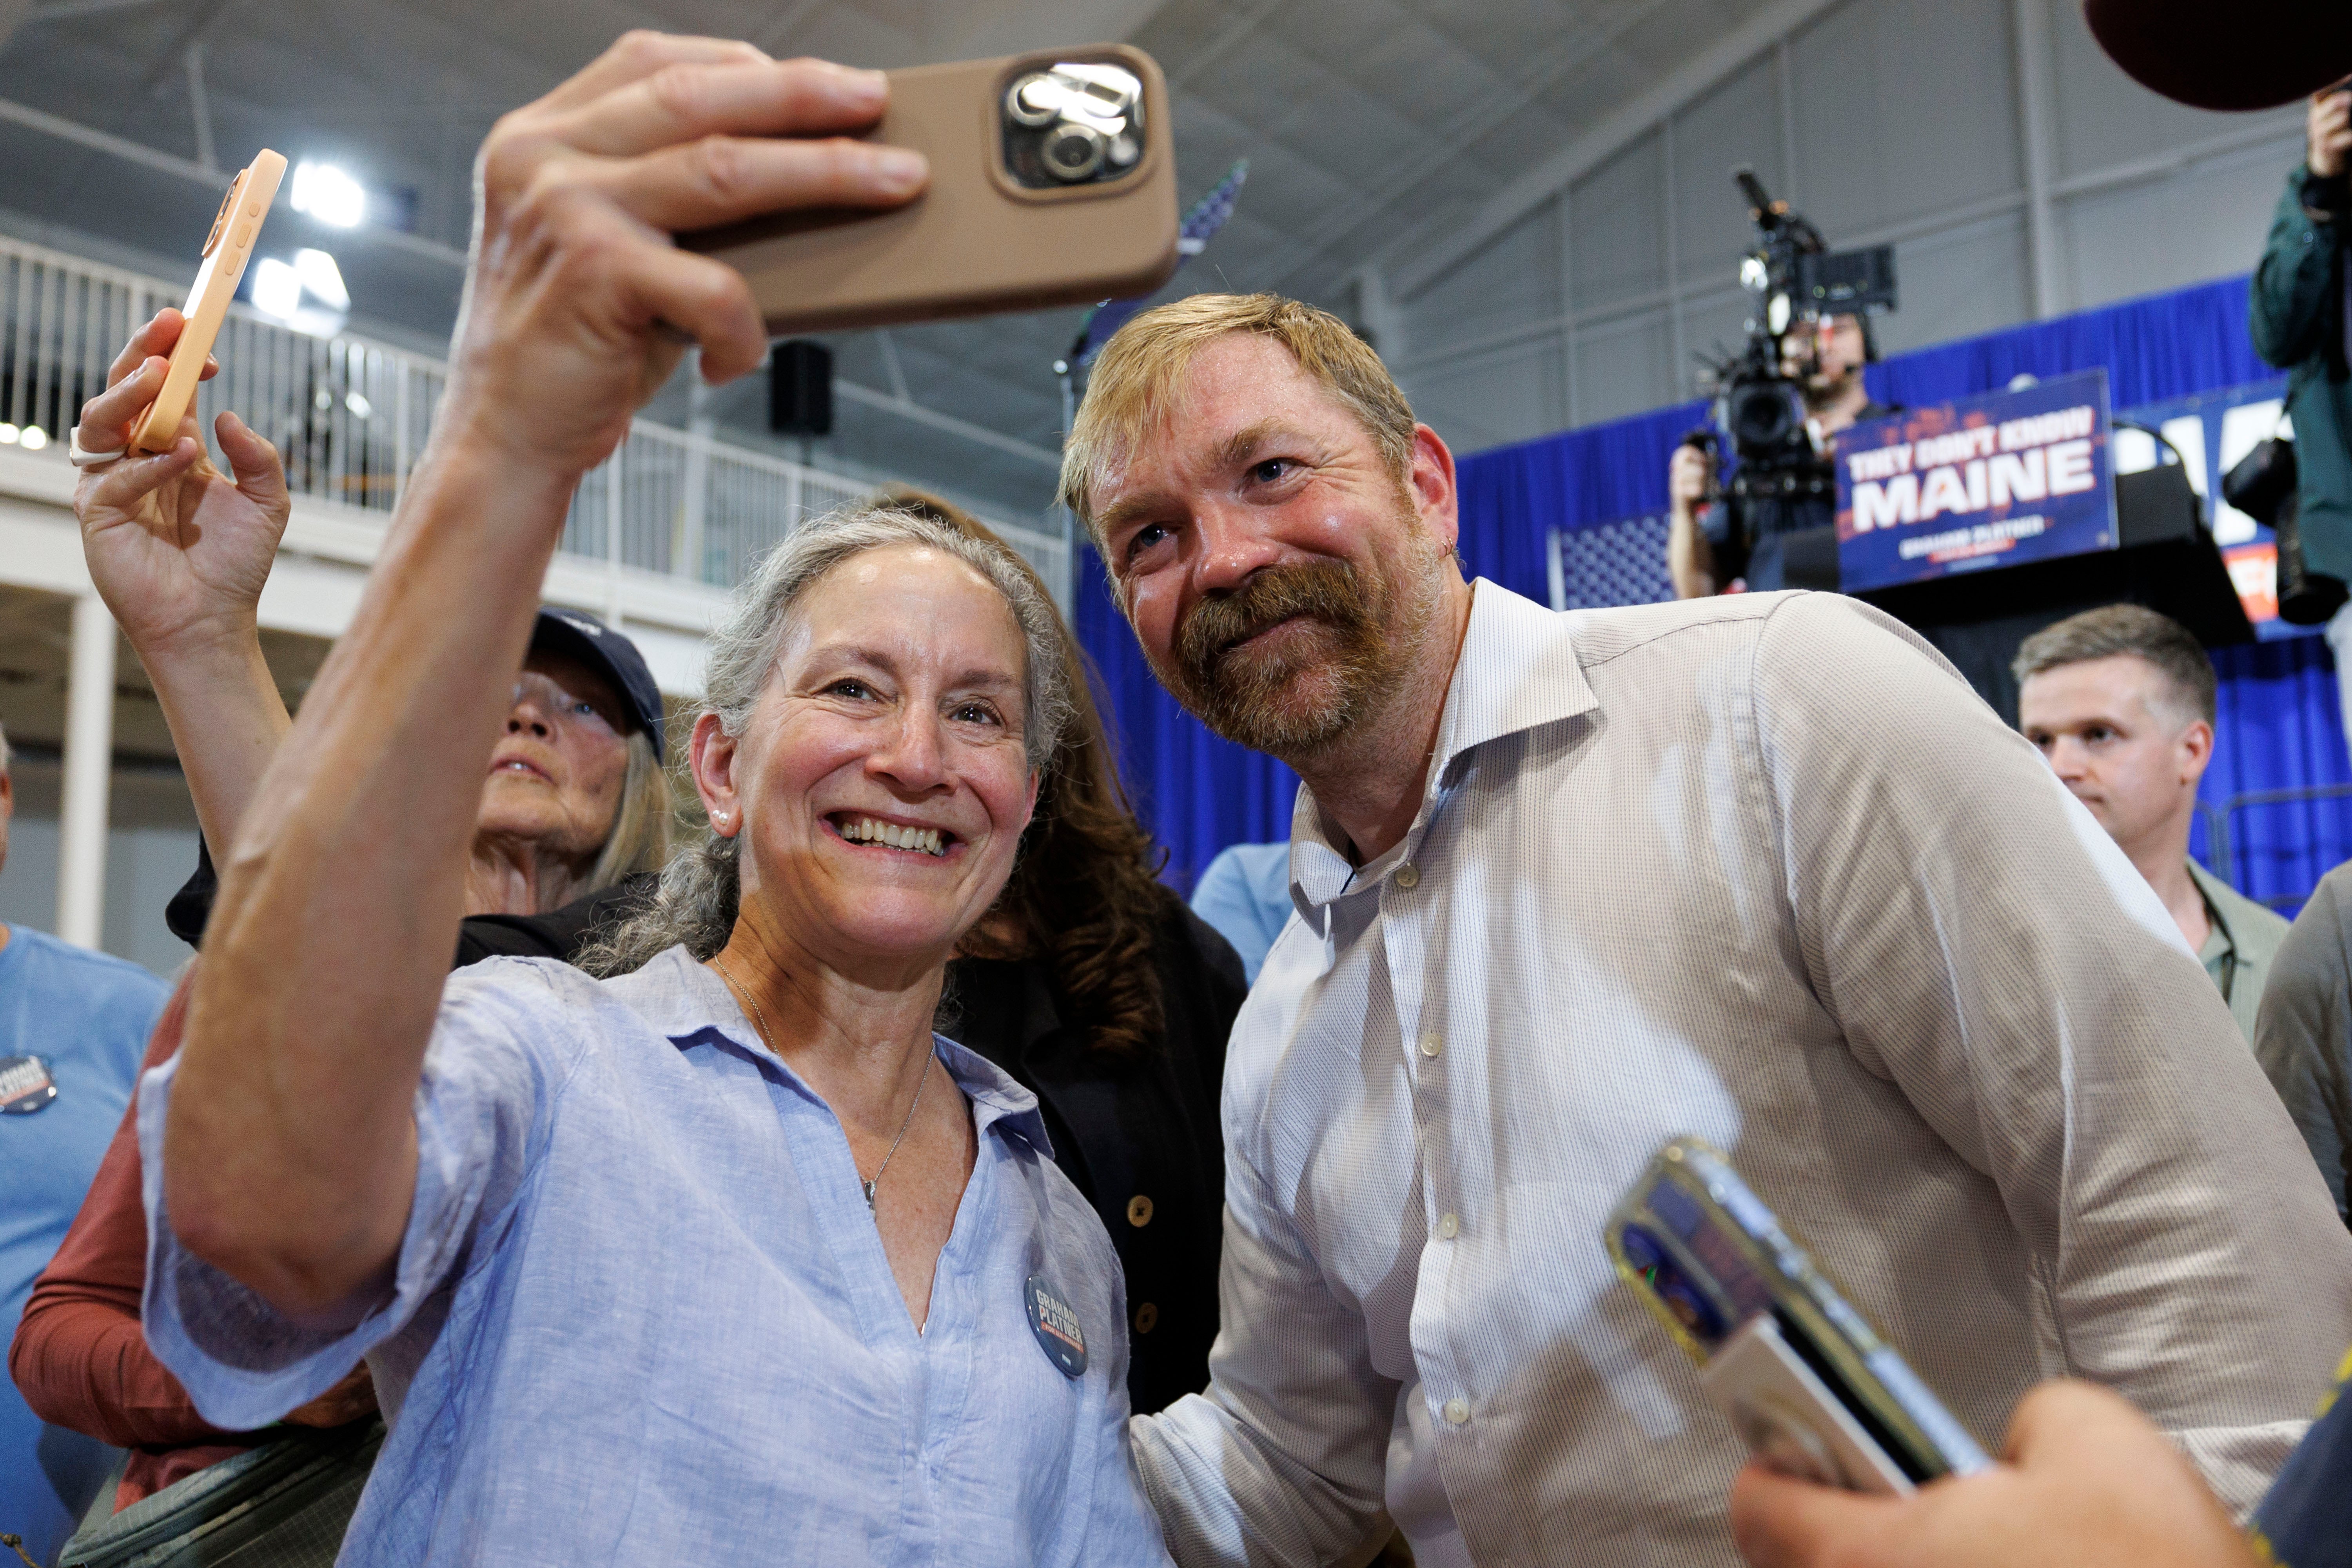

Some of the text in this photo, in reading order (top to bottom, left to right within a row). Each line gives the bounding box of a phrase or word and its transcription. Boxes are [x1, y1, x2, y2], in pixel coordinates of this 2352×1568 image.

[1847, 405, 2094, 483] THEY DON'T KNOW
[1851, 438, 2095, 533] MAINE
[1036, 1289, 1080, 1329] GRAHAM
[1038, 1304, 1083, 1345] PLATNER
